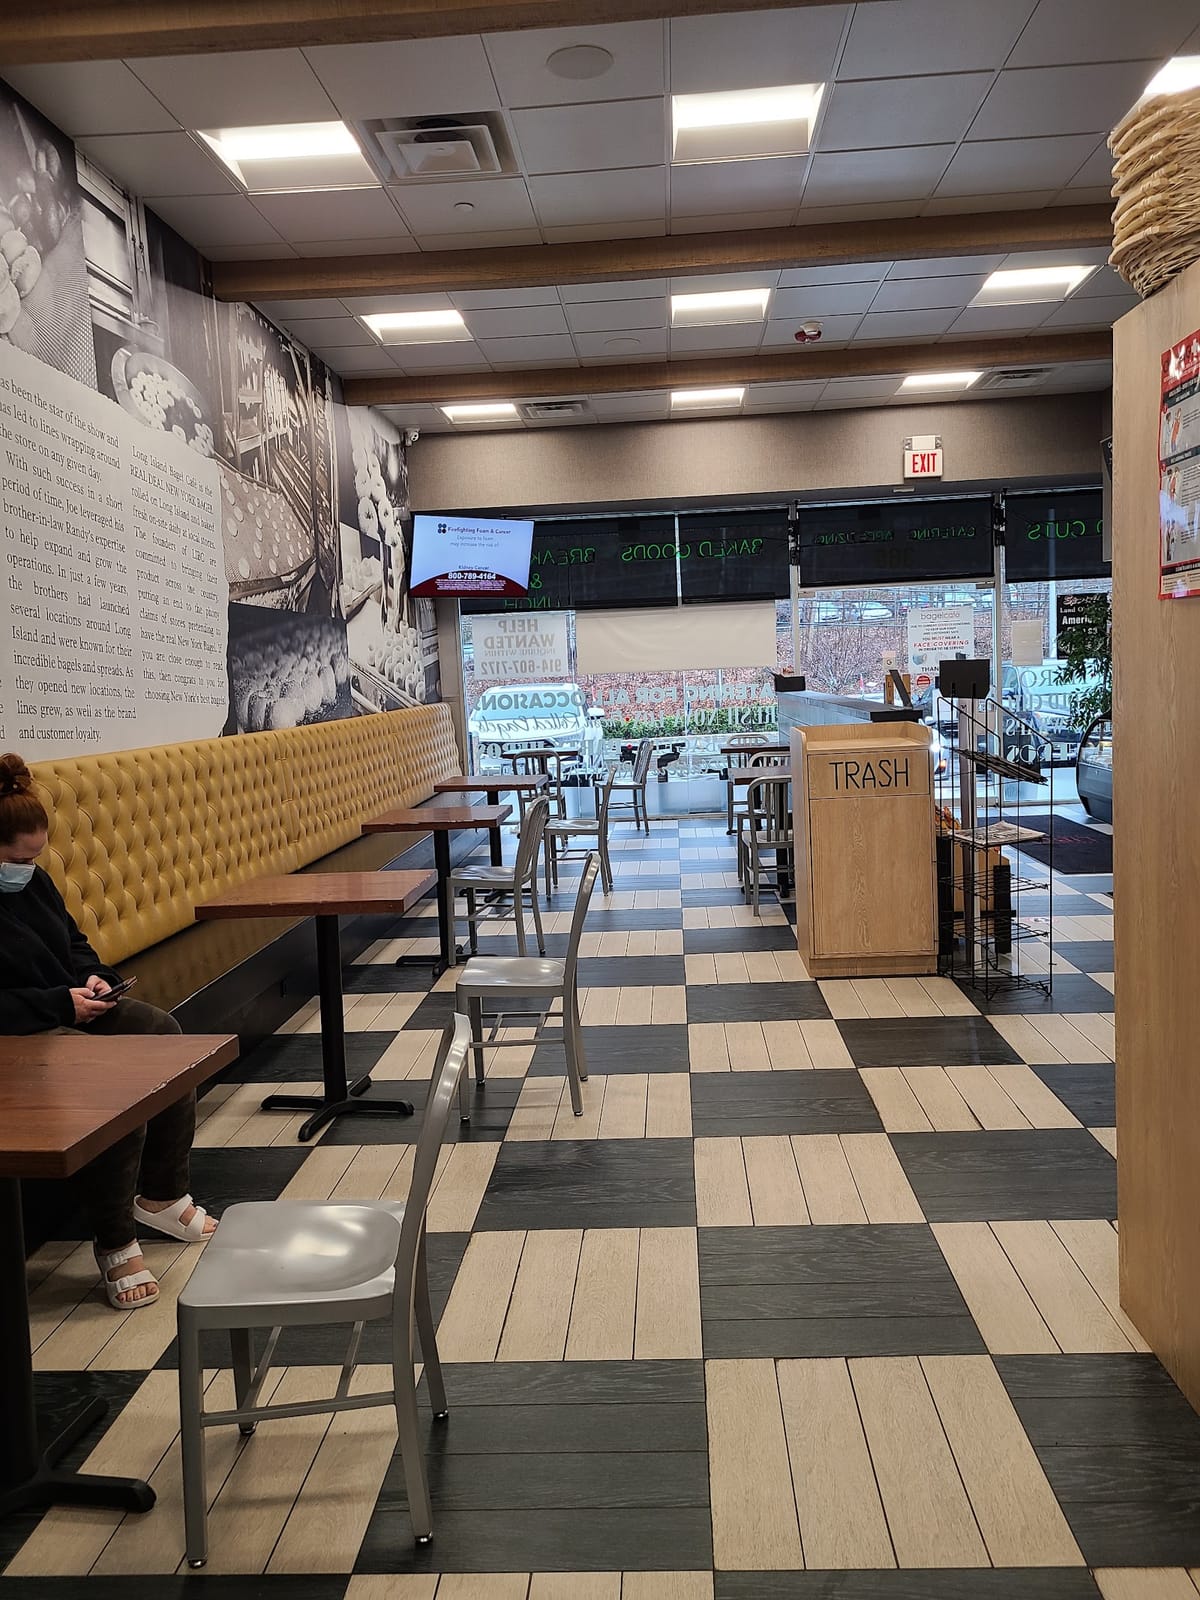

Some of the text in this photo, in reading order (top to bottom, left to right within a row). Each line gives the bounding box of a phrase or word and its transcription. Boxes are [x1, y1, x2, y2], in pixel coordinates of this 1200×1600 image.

[12, 382, 119, 448] been the star of the show and
[14, 405, 120, 469] led to lines wrapping around
[132, 446, 148, 465] Long
[15, 433, 36, 451] store
[38, 444, 49, 457] on
[51, 451, 64, 467] any
[66, 457, 86, 475] given
[88, 466, 102, 482] day.
[912, 453, 937, 472] EXIT
[6, 451, 123, 511] With such success in a short
[2, 476, 124, 532] period of time, Joe leveraged his
[3, 498, 125, 552] brother-in-law Randy's expertise
[134, 526, 146, 540] The
[5, 526, 127, 574] to help expand and grow the
[7, 552, 128, 596] operations. In just a few years,
[8, 575, 130, 616] the brothers had launched
[10, 602, 131, 639] several locations around Long
[12, 626, 132, 657] Island and were known for their
[14, 651, 133, 677] incredible bagels and spreads. As
[16, 676, 33, 693] they
[38, 680, 68, 694] opened
[71, 684, 86, 694] new
[89, 682, 122, 698] locations,
[124, 687, 135, 698] the
[17, 700, 38, 715] lines
[40, 703, 62, 718] grew,
[65, 706, 73, 717] as
[76, 704, 91, 717] well
[95, 708, 102, 718] as
[104, 706, 115, 718] the
[118, 707, 136, 719] brand
[19, 725, 35, 739] and
[37, 727, 73, 740] customer
[75, 726, 101, 742] loyalty.
[829, 758, 909, 790] TRASH
